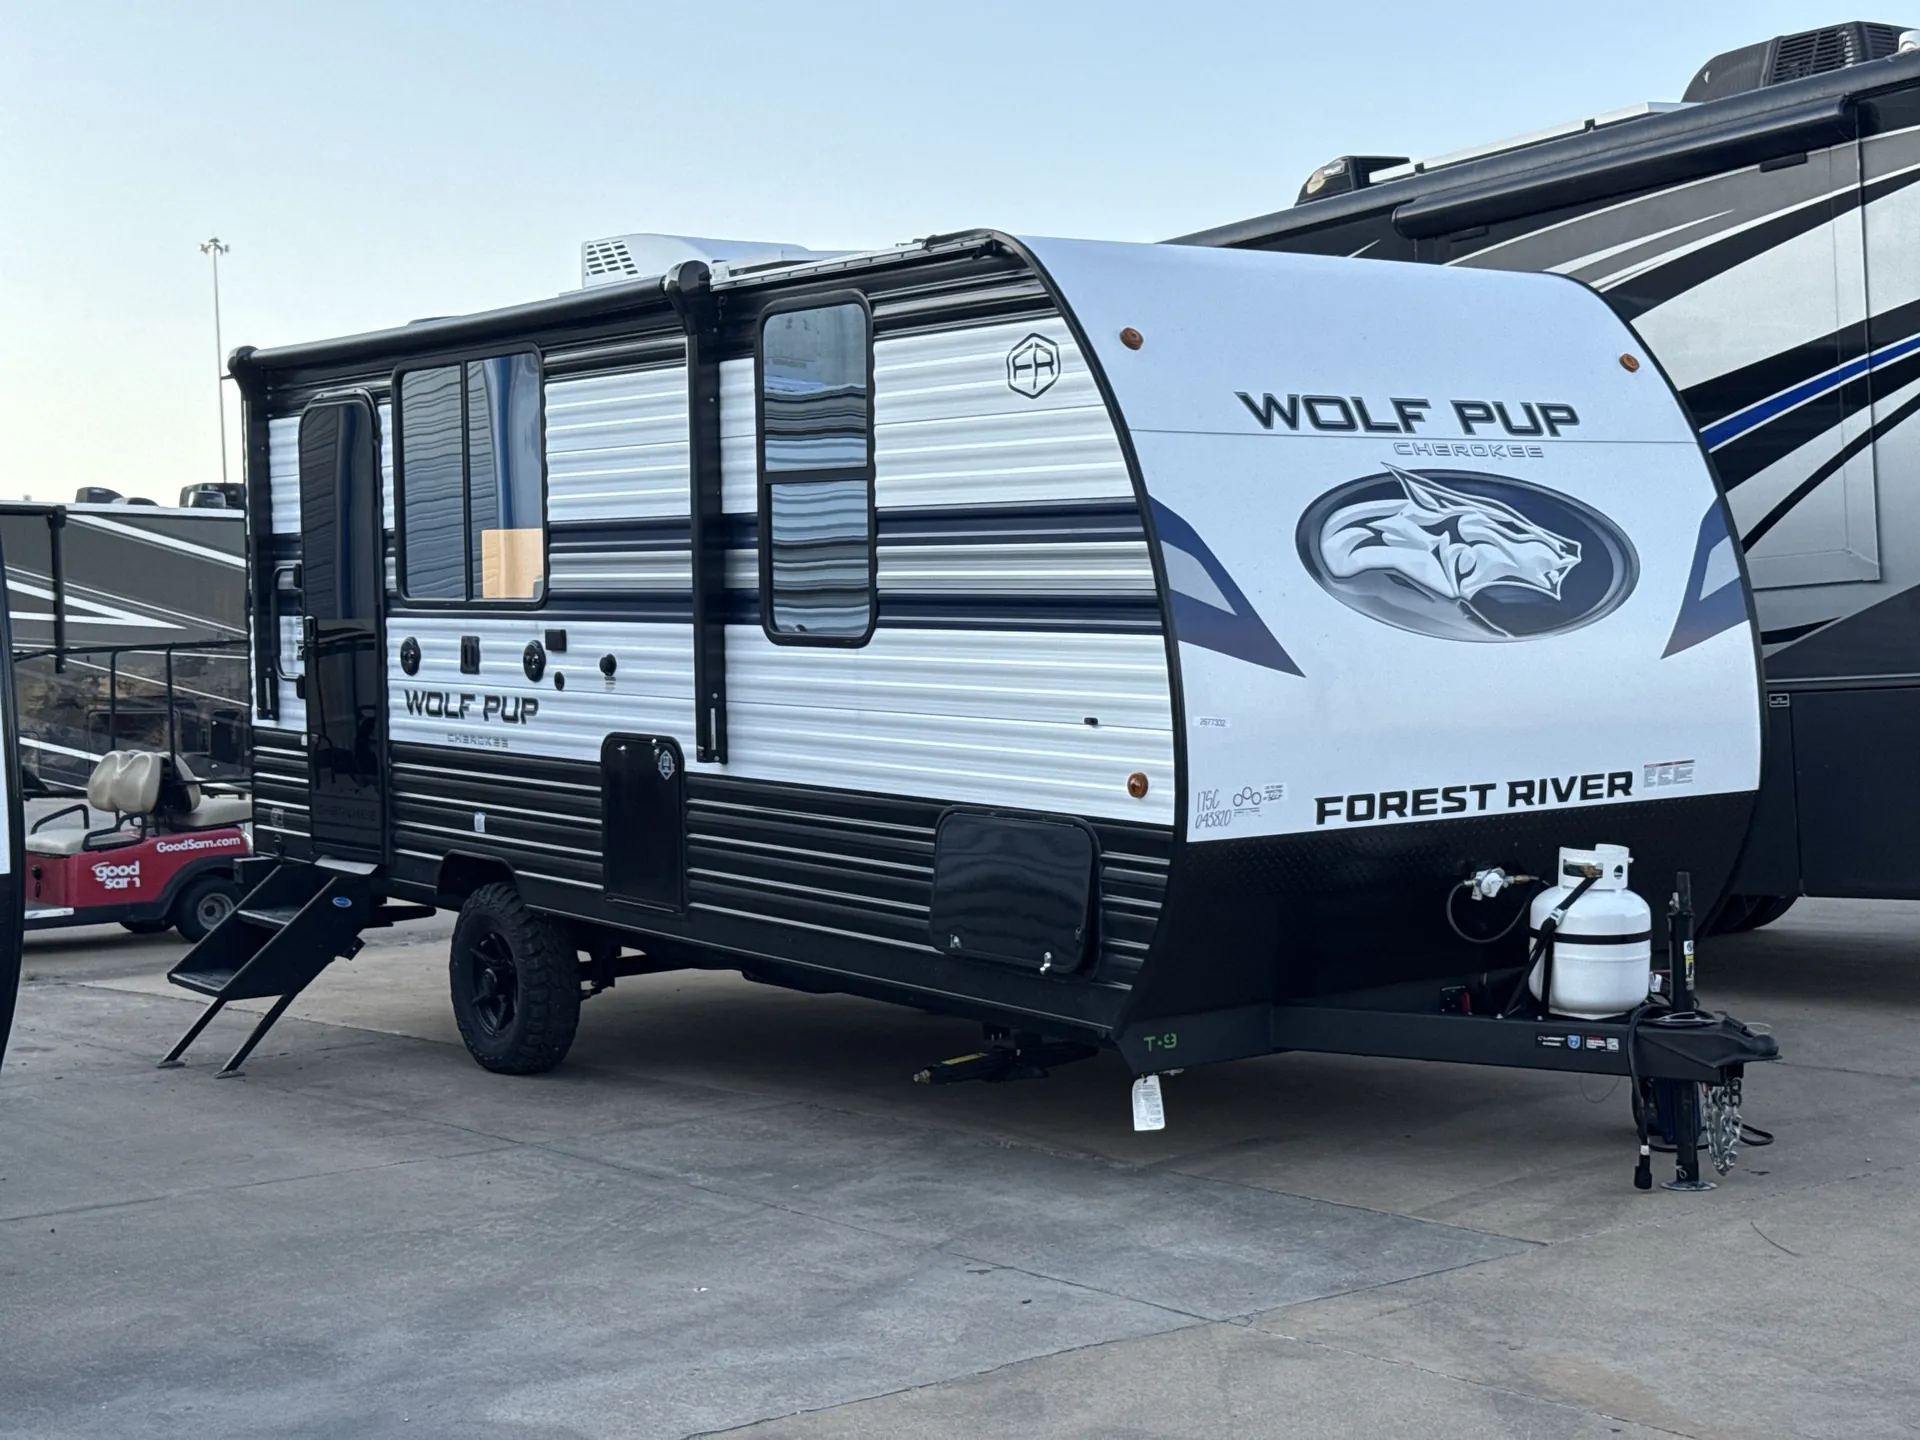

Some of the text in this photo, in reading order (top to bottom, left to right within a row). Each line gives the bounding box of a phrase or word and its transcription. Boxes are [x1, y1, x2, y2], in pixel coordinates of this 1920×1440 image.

[1233, 391, 1581, 437] WOLF PUP
[1393, 442, 1545, 459] CHEROKEE
[404, 688, 539, 724] WOLF PUP
[447, 733, 509, 748] CHEROKEE
[1314, 783, 1497, 825] FOREST
[1506, 771, 1633, 807] RIVER
[156, 836, 241, 853] GoodSam.com
[95, 861, 140, 881] good
